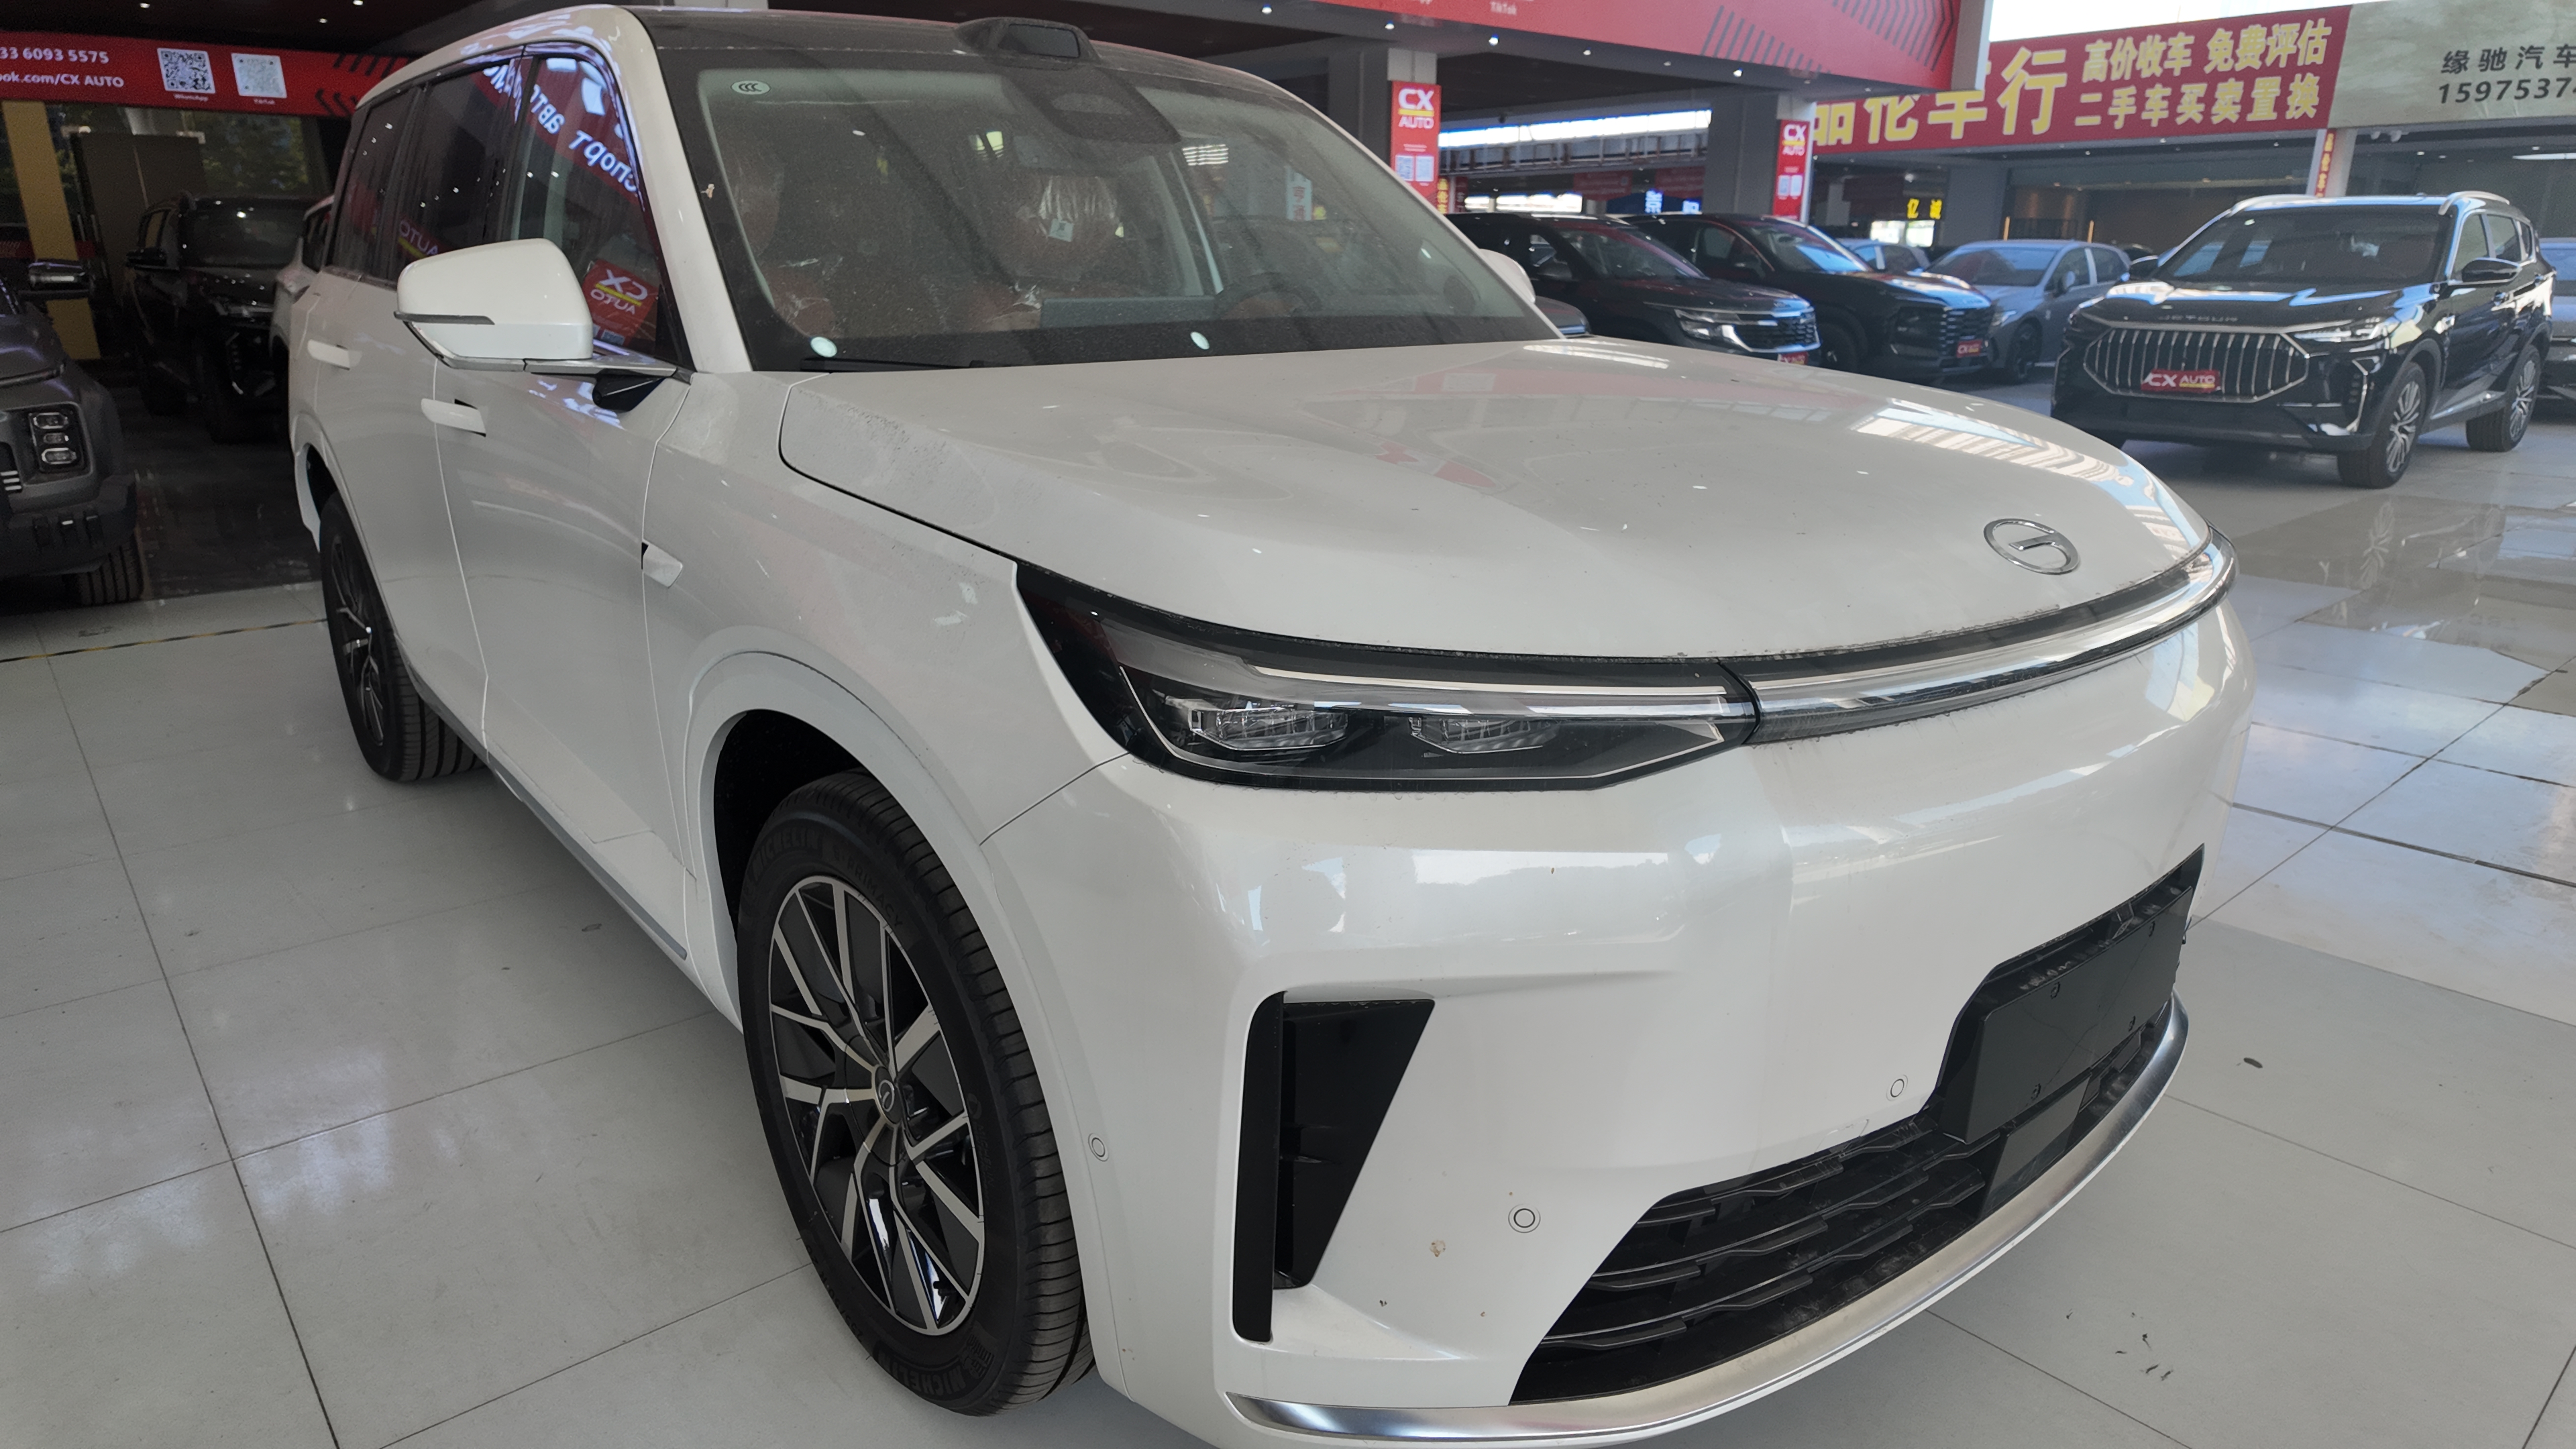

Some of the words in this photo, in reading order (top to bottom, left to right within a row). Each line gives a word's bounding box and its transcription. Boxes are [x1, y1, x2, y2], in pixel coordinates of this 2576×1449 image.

[23, 47, 64, 61] 6093
[68, 49, 109, 64] 5575
[2082, 31, 2195, 83] 高价收车
[2204, 18, 2332, 74] 免费评估
[2440, 43, 2576, 74] 缘驰汽车
[0, 70, 80, 86] ok.com/CX
[84, 74, 125, 88] AUTO
[1398, 88, 1434, 111] CX
[2438, 76, 2576, 104] 1597537
[2074, 72, 2320, 130] 二手车买卖置换
[1398, 115, 1434, 129] AUTO
[1783, 123, 1807, 142] CX
[1782, 145, 1805, 156] AUTO
[2147, 374, 2178, 387] CX
[2180, 374, 2215, 384] AUTO
[877, 1350, 967, 1395] MICHELIN
